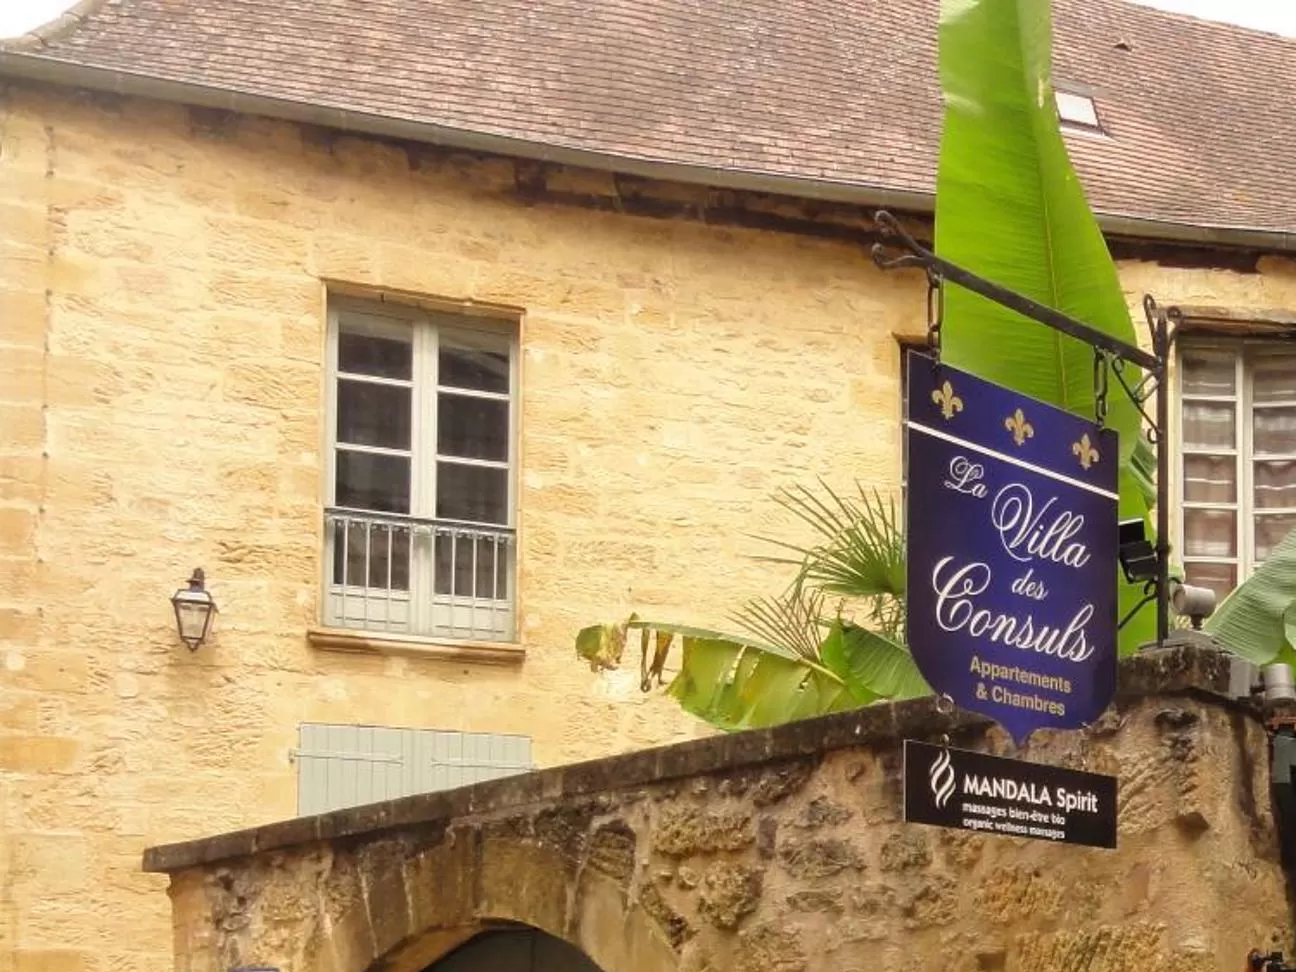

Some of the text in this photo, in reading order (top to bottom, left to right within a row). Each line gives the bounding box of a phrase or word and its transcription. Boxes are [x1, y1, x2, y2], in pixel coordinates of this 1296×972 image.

[944, 456, 1091, 569] La Villa
[1011, 569, 1048, 601] des
[932, 556, 1095, 663] Consuls
[970, 655, 1072, 694] Appartements
[975, 682, 1066, 717] & Chambres
[962, 803, 1007, 818] massages
[963, 773, 1098, 813] MANDALA Spirit
[962, 818, 994, 830] organic
